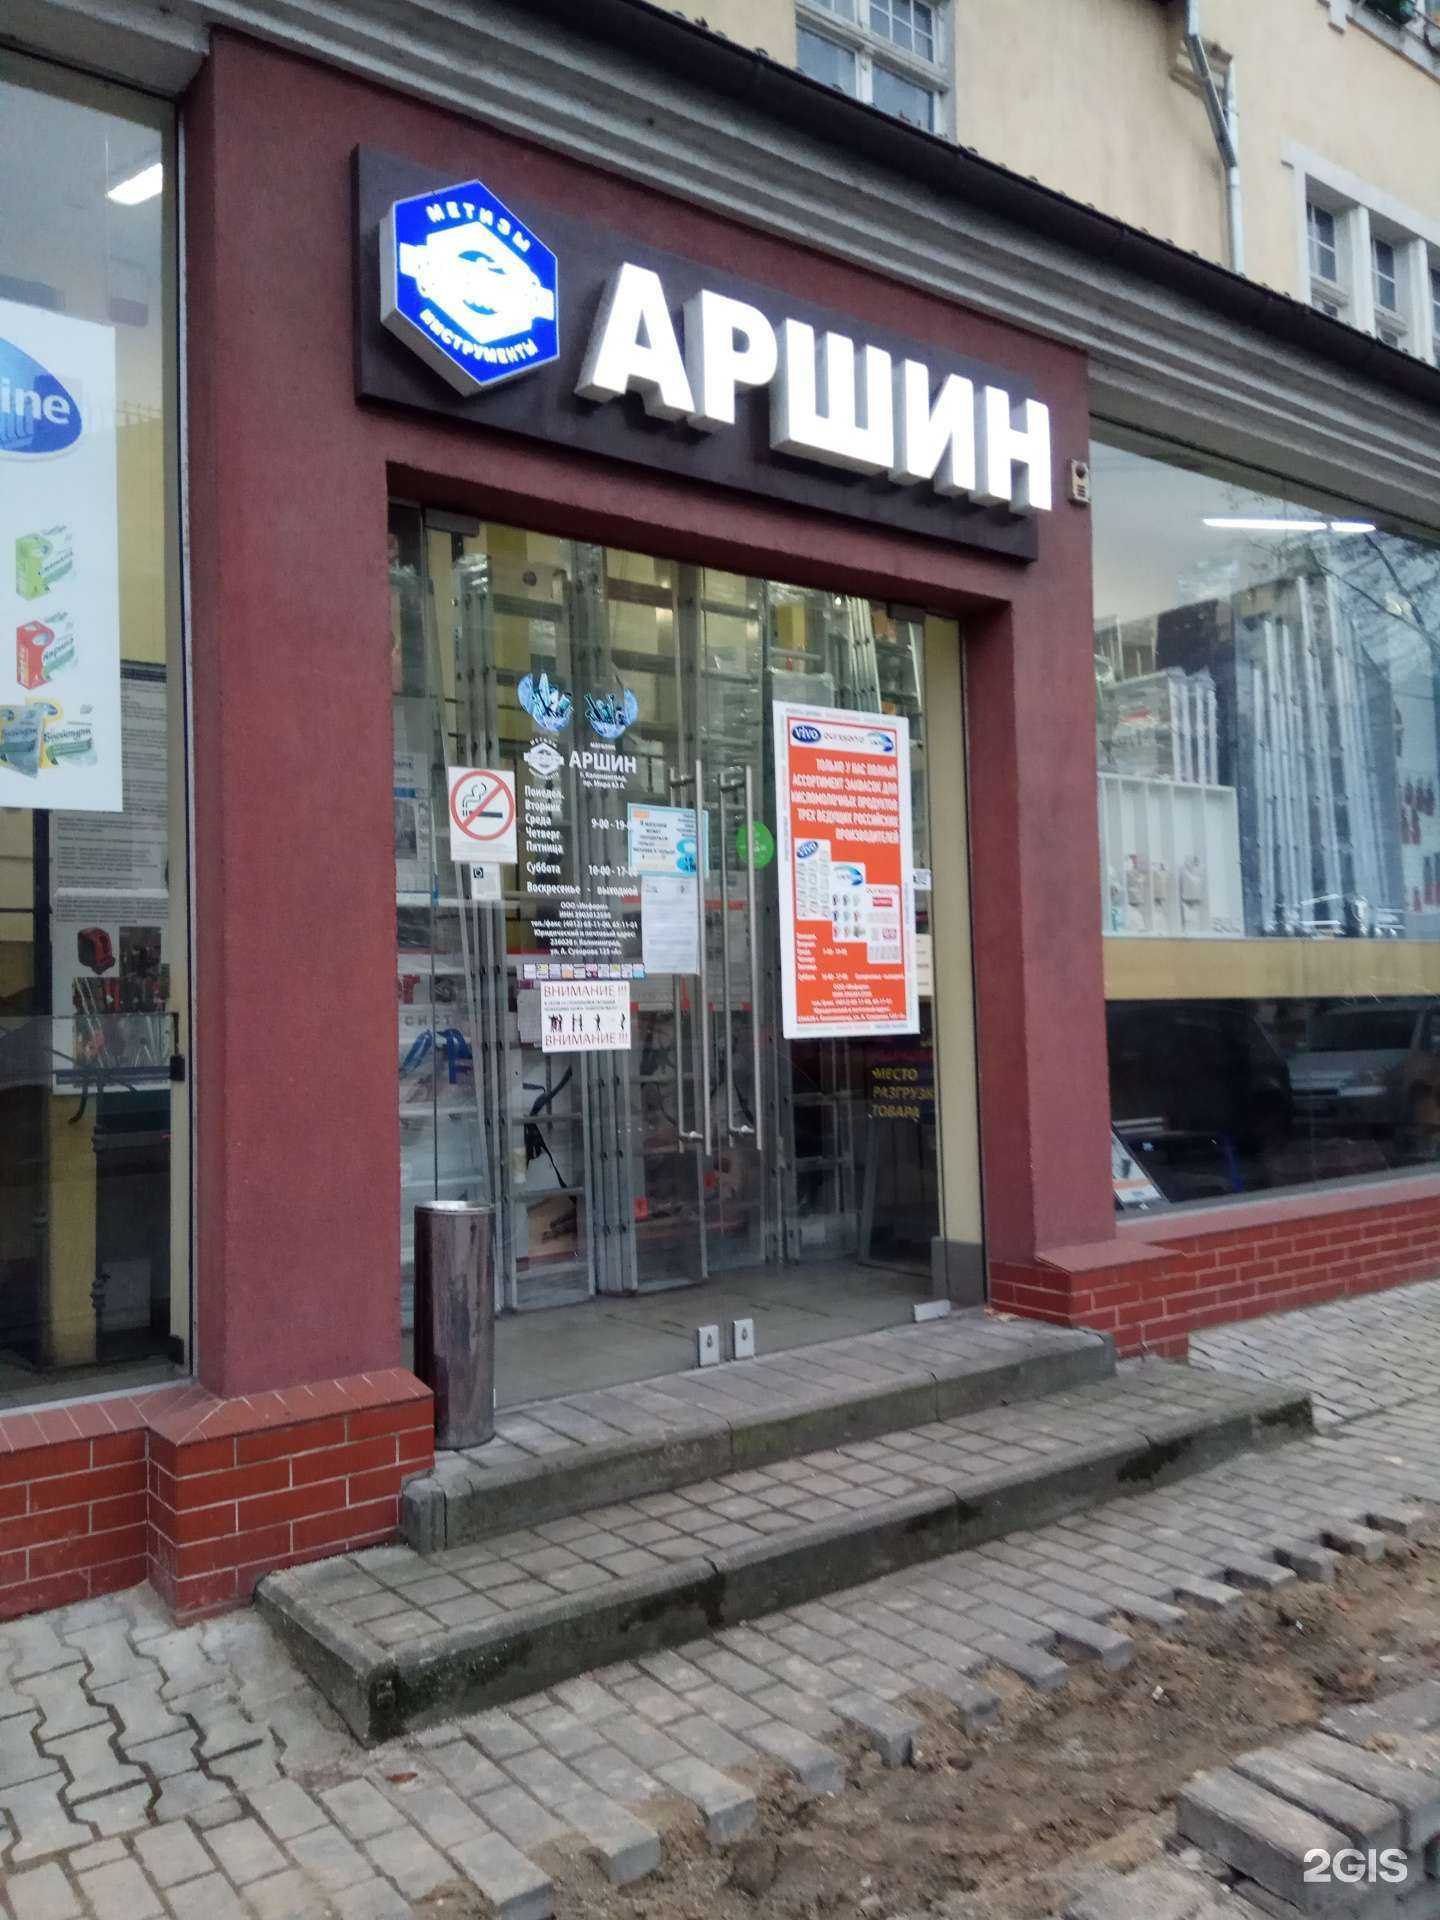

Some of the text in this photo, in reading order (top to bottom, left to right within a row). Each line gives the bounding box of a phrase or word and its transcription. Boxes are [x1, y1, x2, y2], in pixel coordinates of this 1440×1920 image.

[425, 201, 532, 253] МЕТИЗЫ
[419, 308, 540, 365] ИНСТРУМЕНТЫ
[578, 262, 1053, 513] АРШИН
[569, 750, 637, 775] АРШИН
[524, 799, 561, 813] Вторник
[525, 814, 552, 827] Среда
[591, 818, 609, 831] 9-00
[525, 827, 561, 842] Четверг
[526, 841, 564, 855] Пятница
[526, 862, 561, 875] Суббота
[527, 882, 581, 897] Воскресенье
[597, 885, 639, 898] выходной
[544, 985, 615, 998] ВНИМАНИЕ
[545, 1032, 616, 1046] ВНИМАНИЕ
